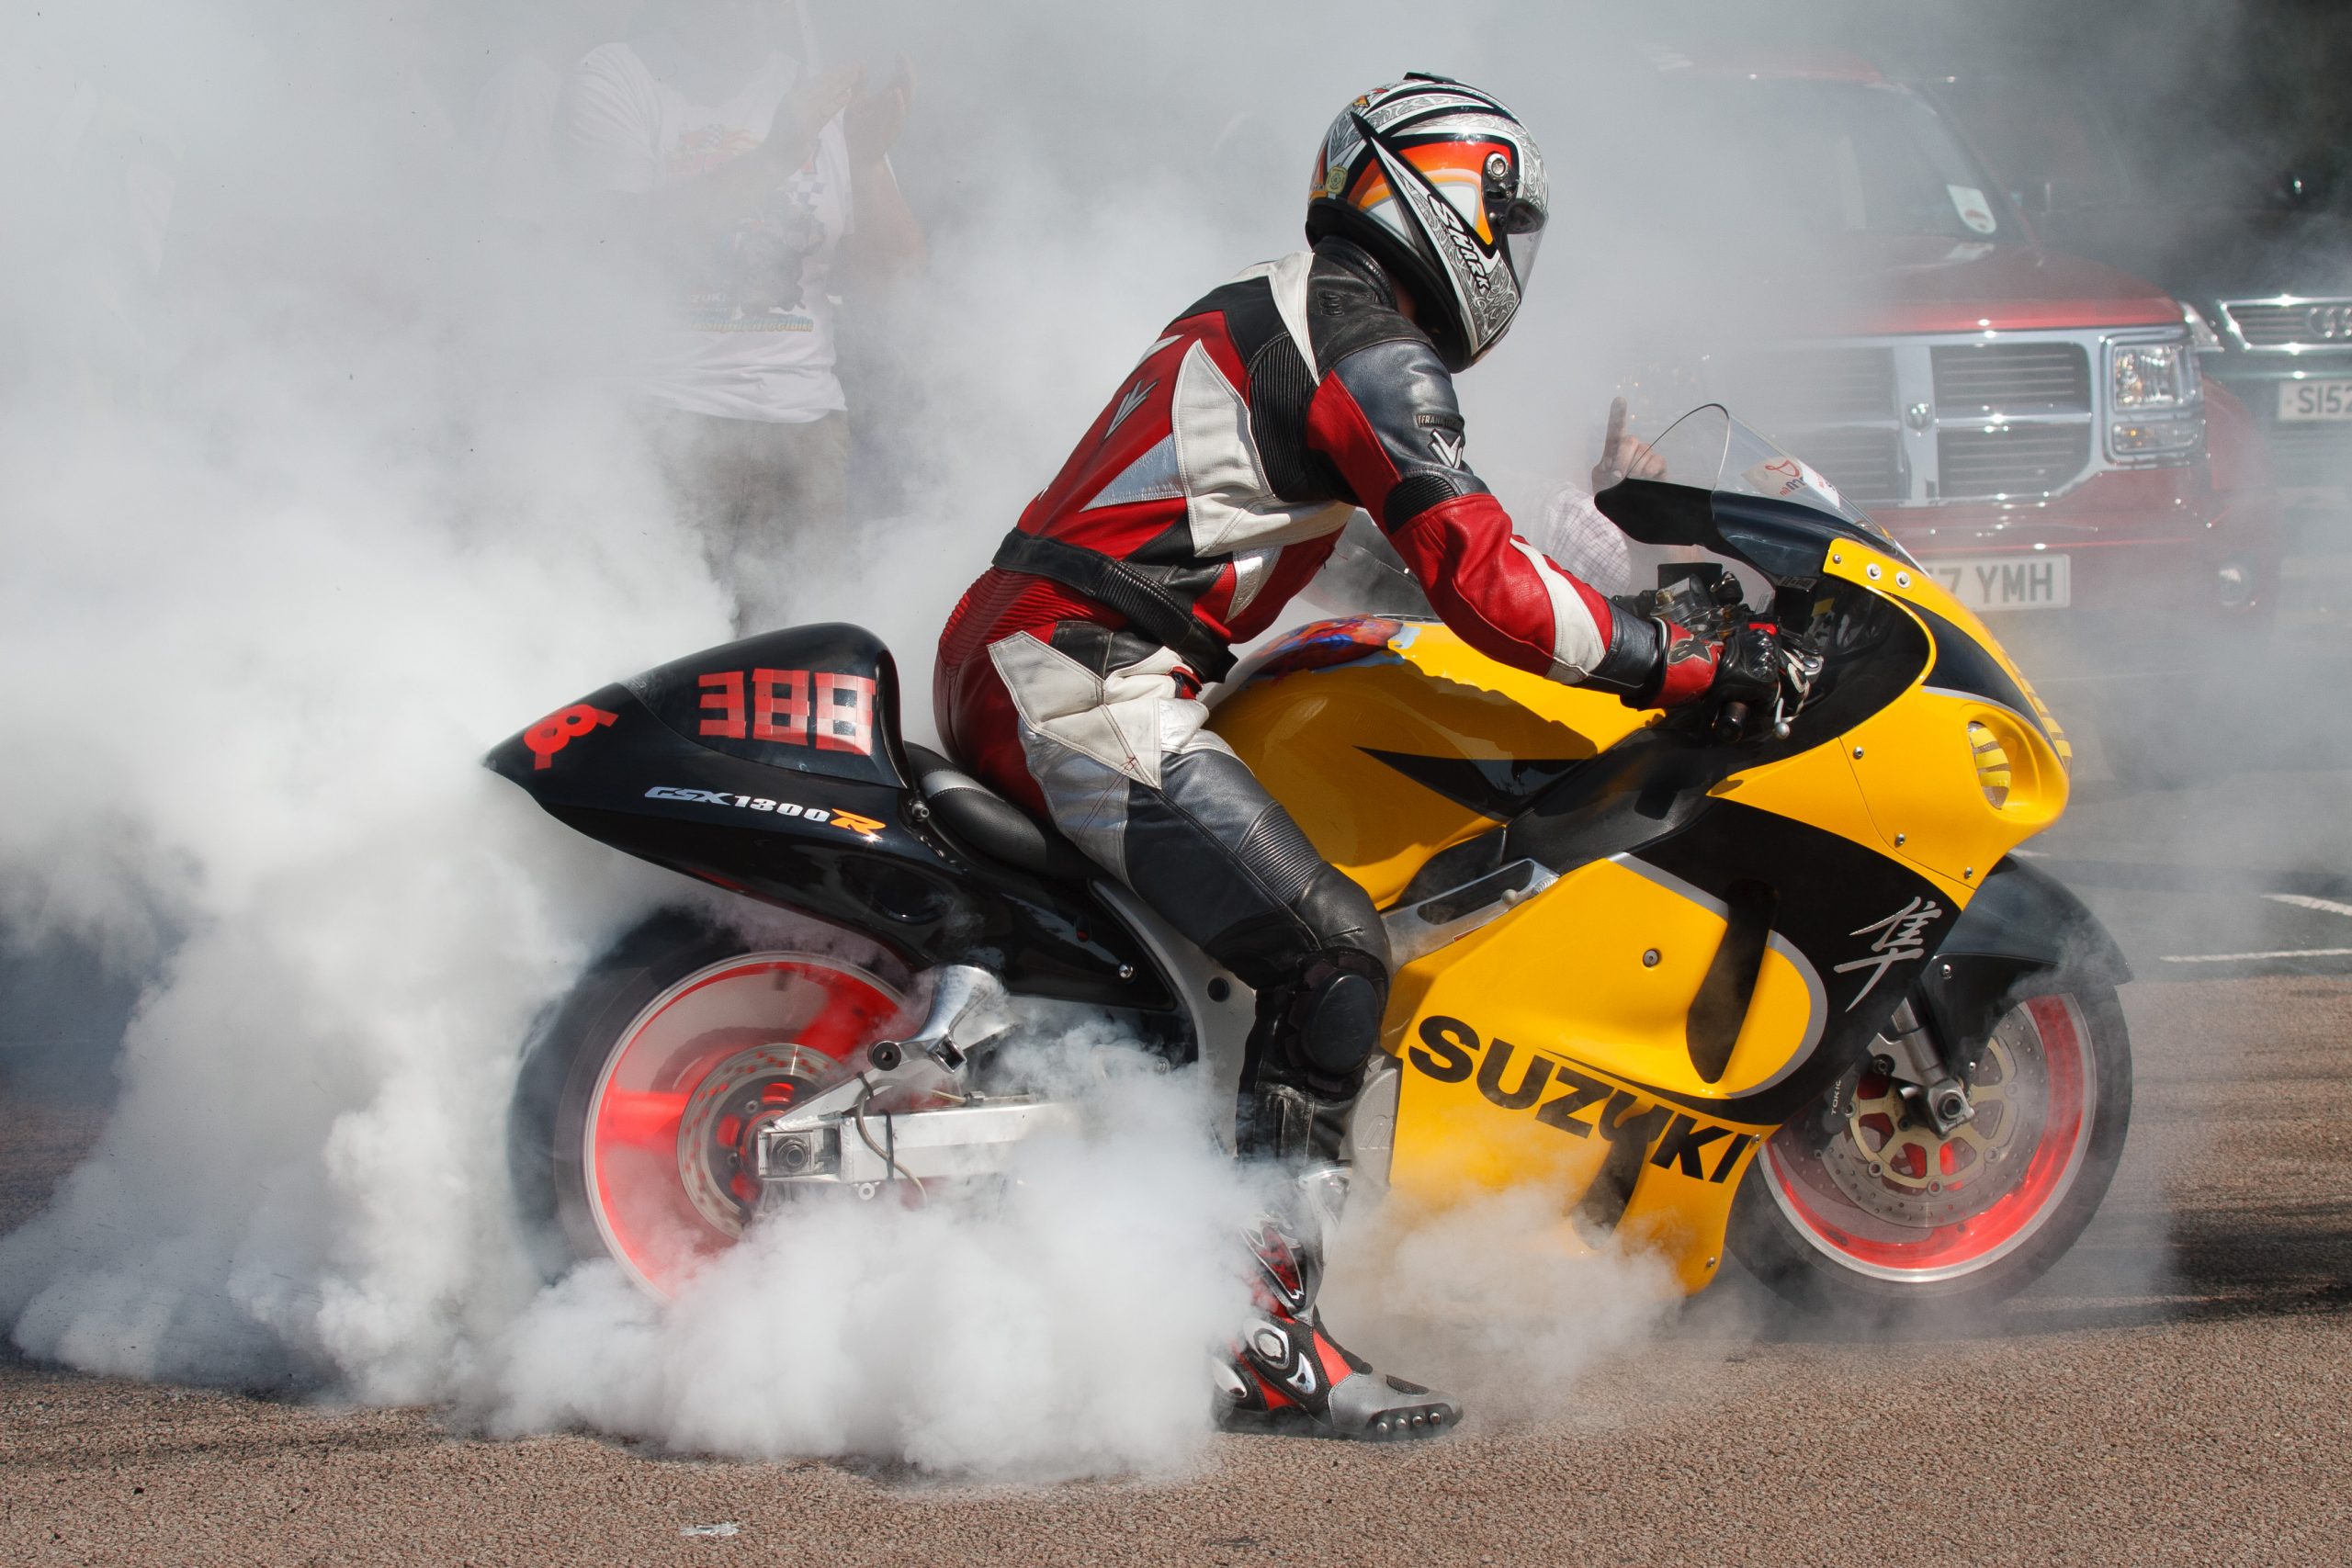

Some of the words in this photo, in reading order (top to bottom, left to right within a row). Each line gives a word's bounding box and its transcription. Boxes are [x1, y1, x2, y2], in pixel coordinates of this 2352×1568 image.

[1427, 193, 1492, 293] SHARK
[1976, 562, 2054, 604] YMH
[698, 667, 876, 756] 388
[1408, 1014, 1750, 1184] SUZUKI
[1830, 1079, 1842, 1116] TOKIC
